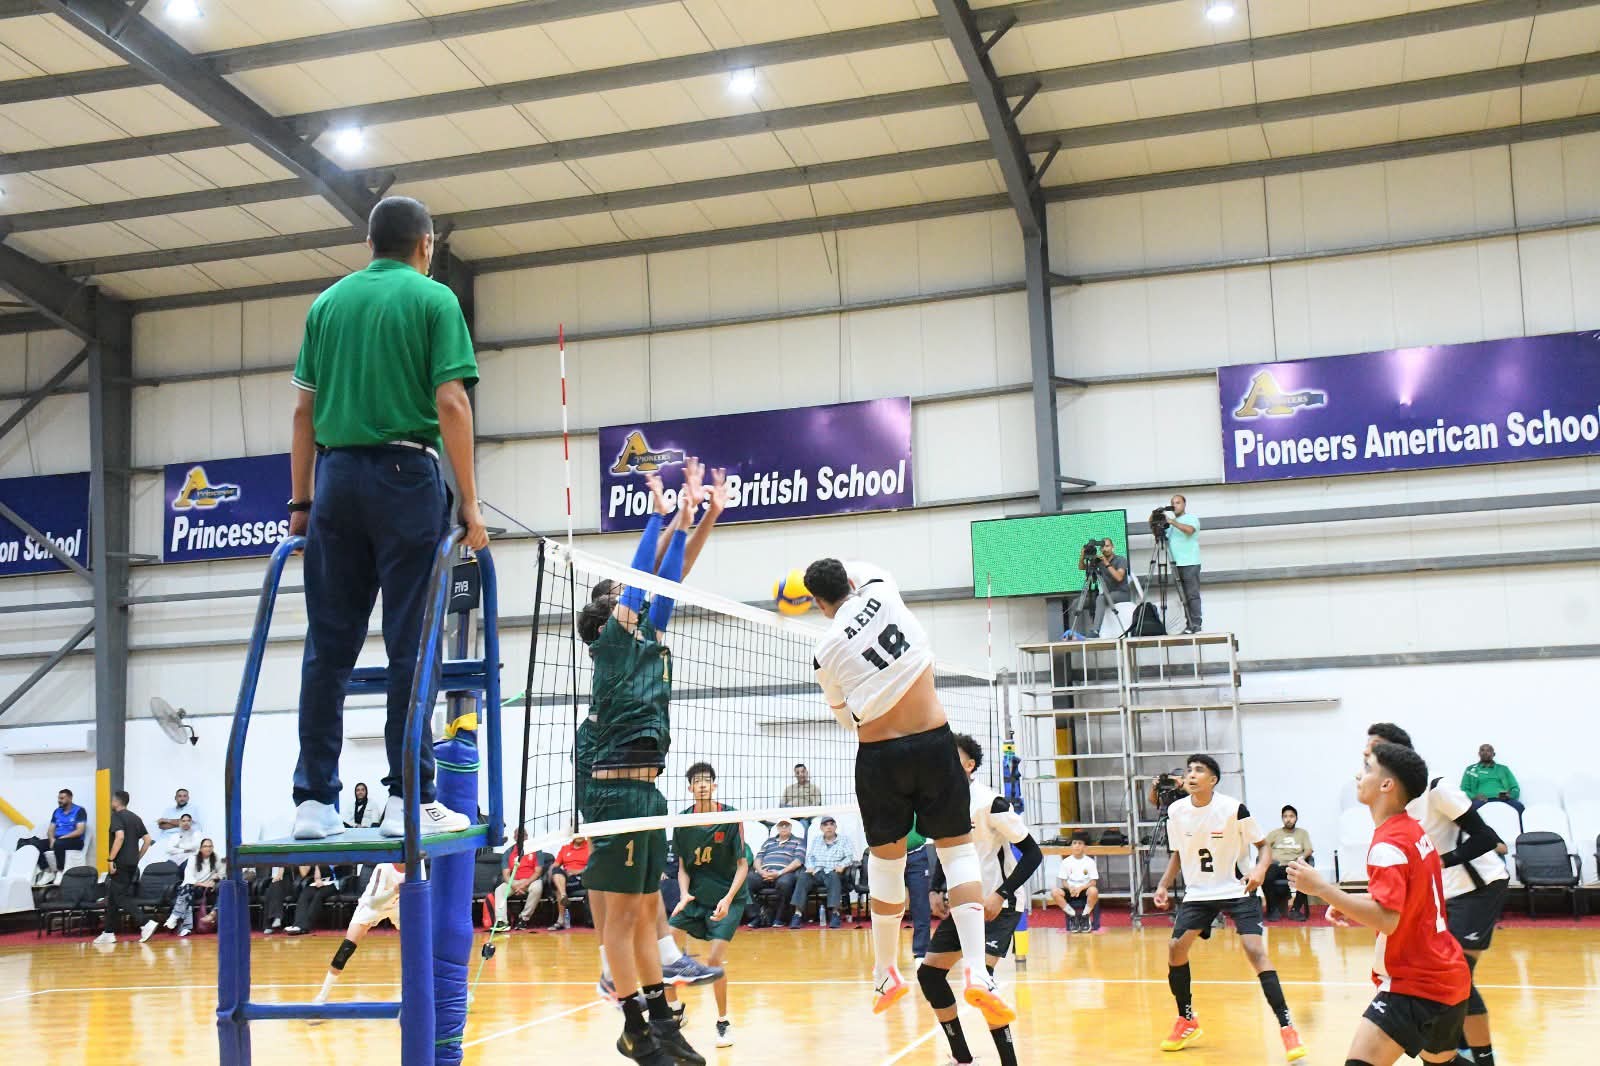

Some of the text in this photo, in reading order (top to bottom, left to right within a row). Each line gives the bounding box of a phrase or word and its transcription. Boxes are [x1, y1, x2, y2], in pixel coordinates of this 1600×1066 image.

[1234, 429, 1358, 469] Pioneers
[1364, 417, 1499, 460] American
[725, 470, 808, 509] British
[816, 459, 906, 501] School
[170, 515, 291, 553] Princesses
[843, 597, 882, 640] A.EID
[624, 838, 635, 868] 1
[692, 846, 714, 867] 14
[1198, 847, 1214, 873] 2
